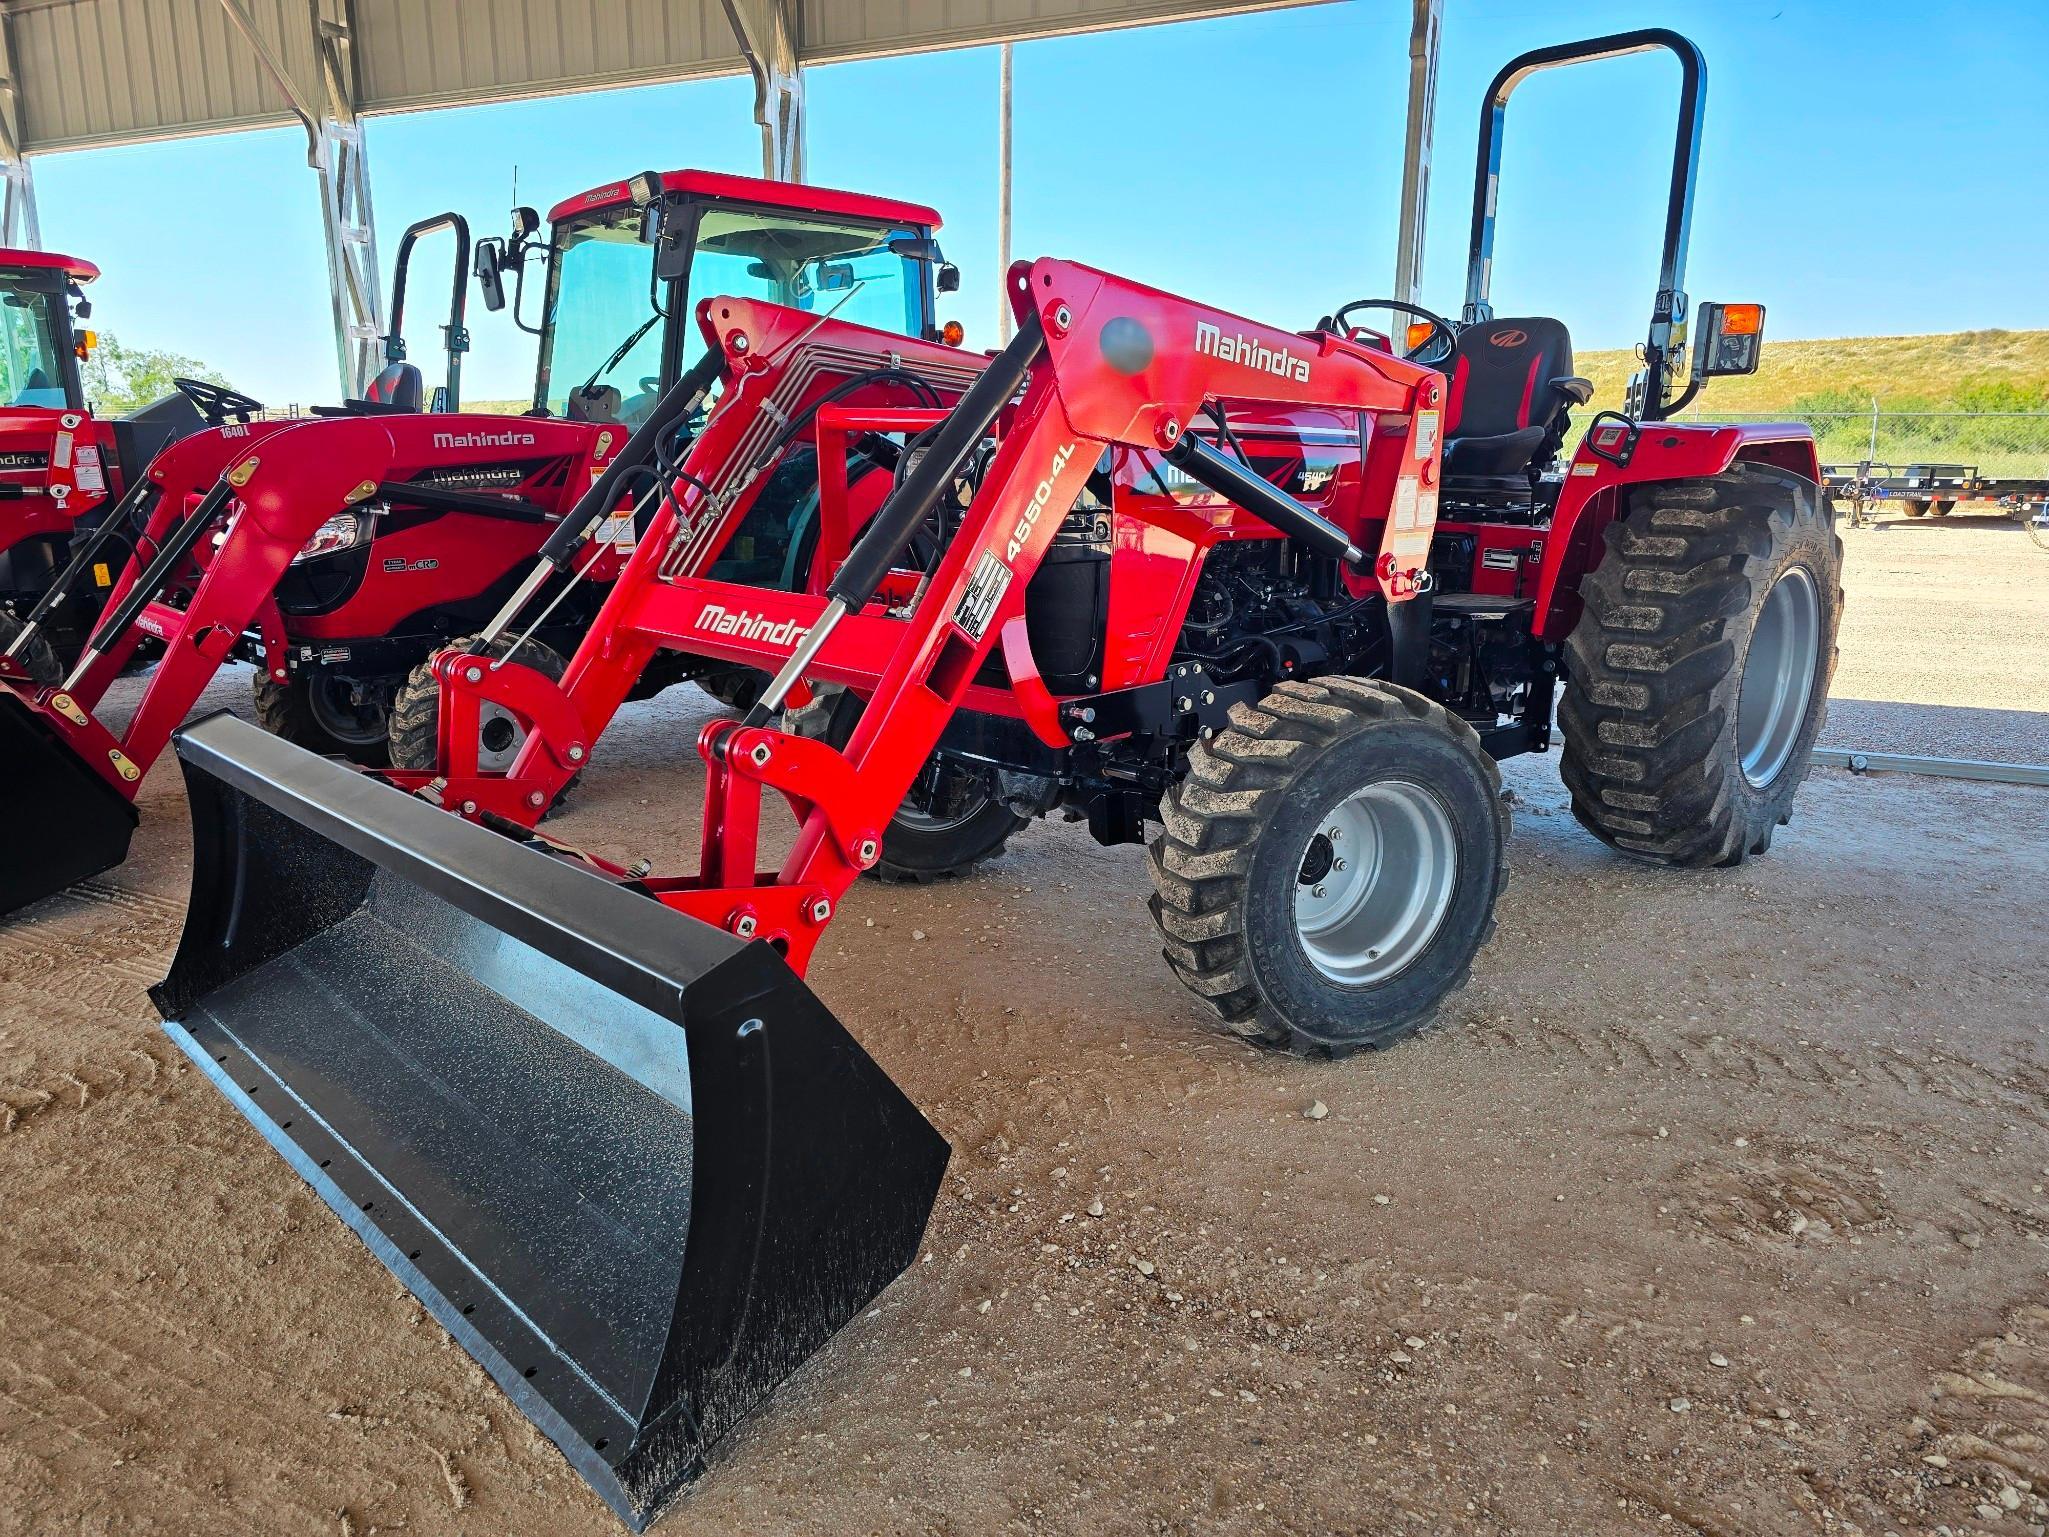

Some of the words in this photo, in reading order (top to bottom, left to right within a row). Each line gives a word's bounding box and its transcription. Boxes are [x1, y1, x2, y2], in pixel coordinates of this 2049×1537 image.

[1195, 320, 1310, 383] Mahindra
[433, 430, 535, 448] Mahindra
[1297, 471, 1327, 481] 4540
[1007, 443, 1076, 562] 4550-4L
